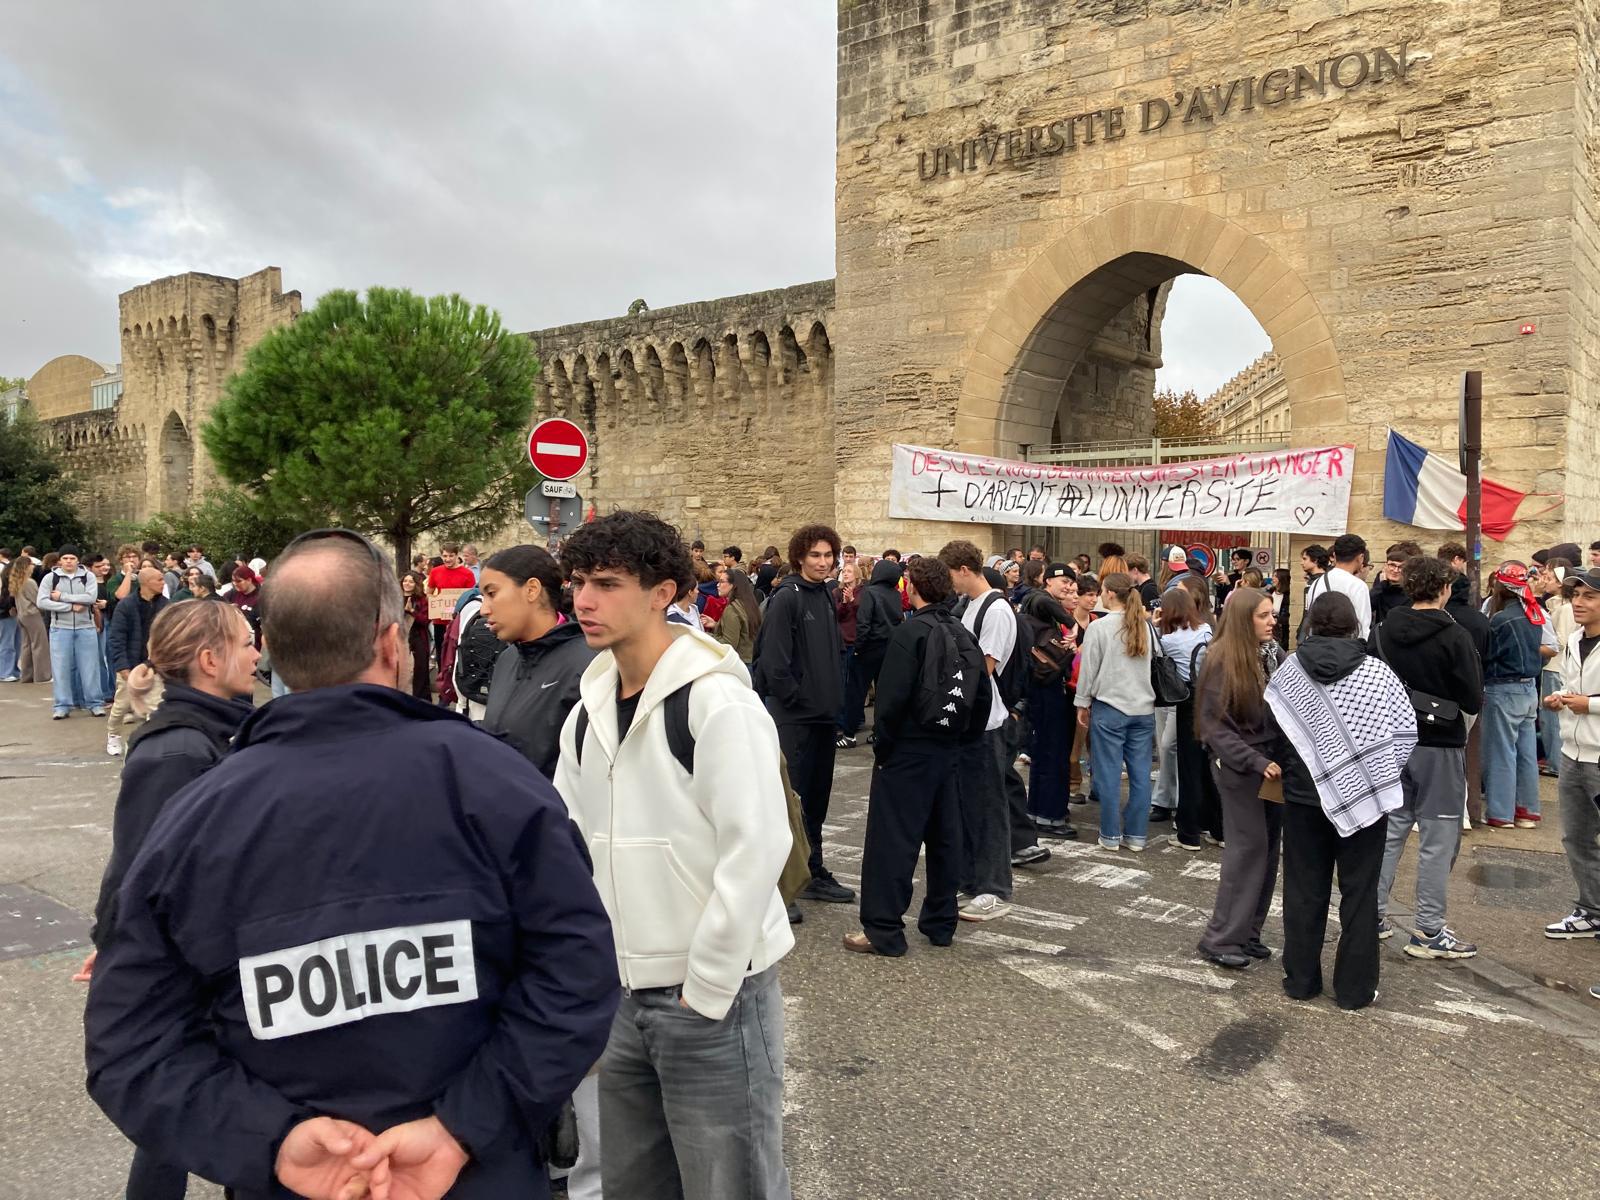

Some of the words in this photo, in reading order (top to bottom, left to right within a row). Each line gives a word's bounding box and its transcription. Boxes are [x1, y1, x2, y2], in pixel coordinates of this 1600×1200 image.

[917, 106, 1126, 181] UNIVERSITE
[1139, 40, 1409, 133] D'AVIGNON
[544, 485, 563, 494] SAUF
[964, 479, 1058, 516] D'ARGENT
[254, 934, 460, 1028] POLICE
